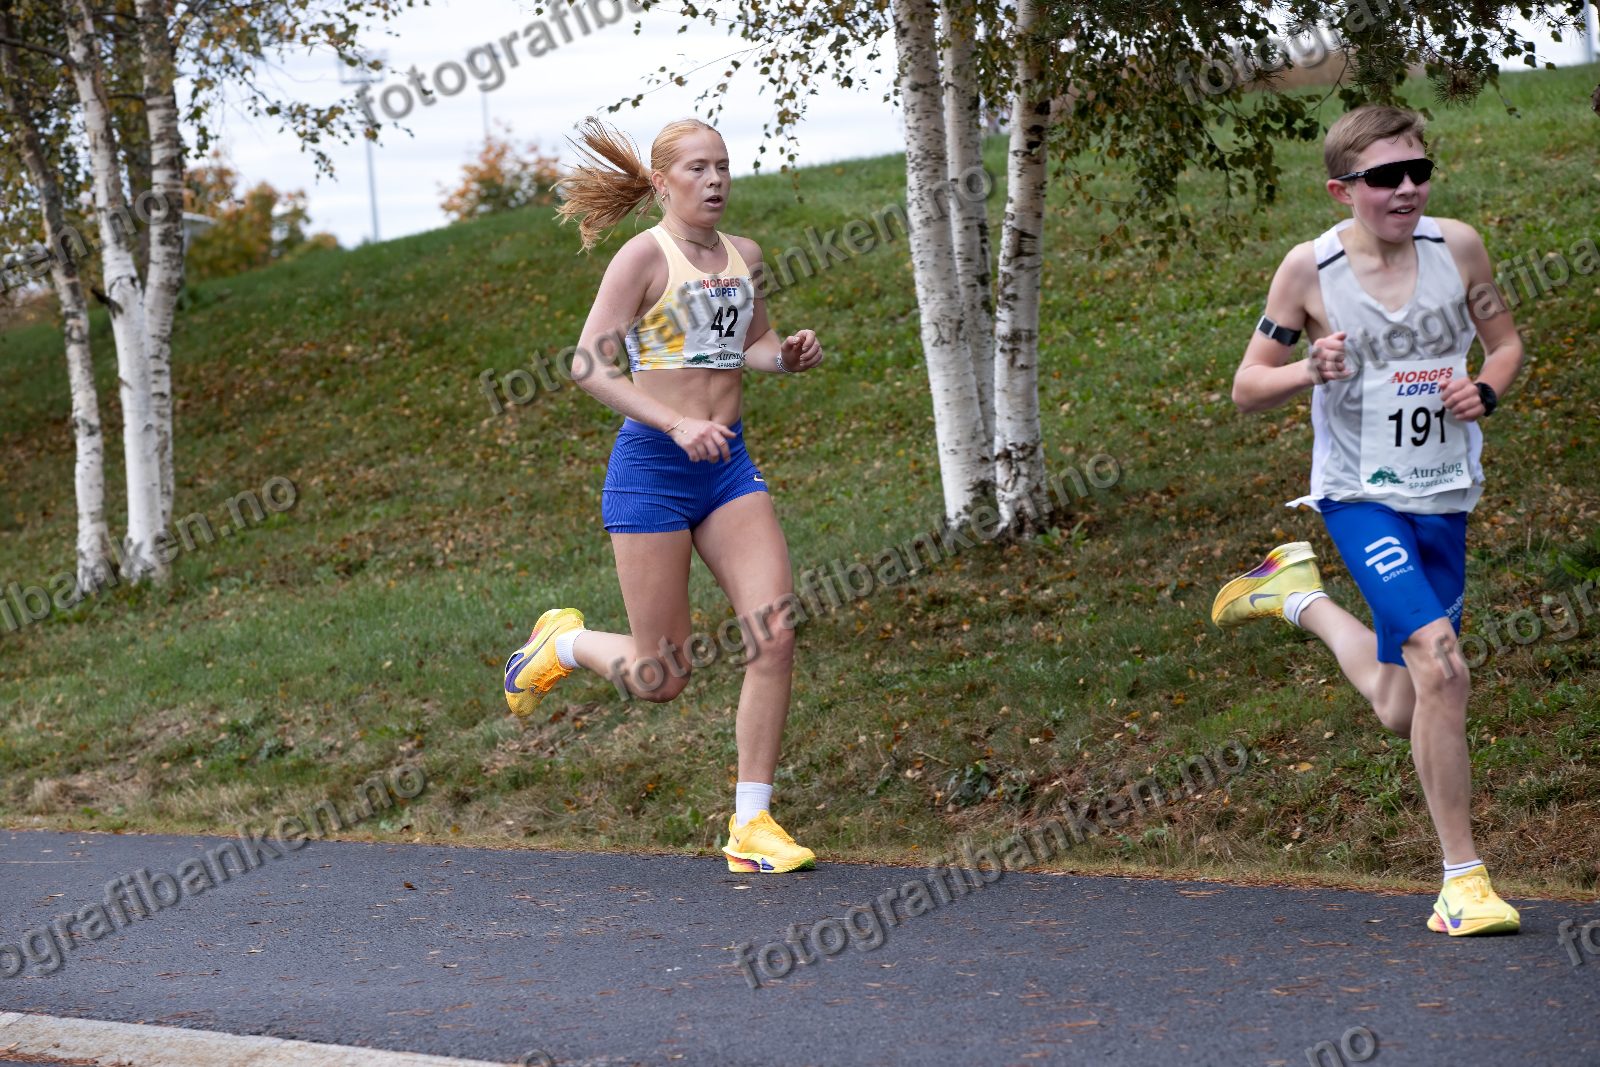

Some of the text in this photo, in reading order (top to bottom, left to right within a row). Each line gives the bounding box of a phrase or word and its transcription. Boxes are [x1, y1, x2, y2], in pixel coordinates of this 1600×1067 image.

[702, 278, 741, 289] NORGES
[709, 288, 737, 297] LØPET
[710, 305, 739, 338] 42
[1397, 382, 1446, 397] LØPE
[1388, 406, 1446, 447] 191
[1409, 462, 1464, 480] Aurskog
